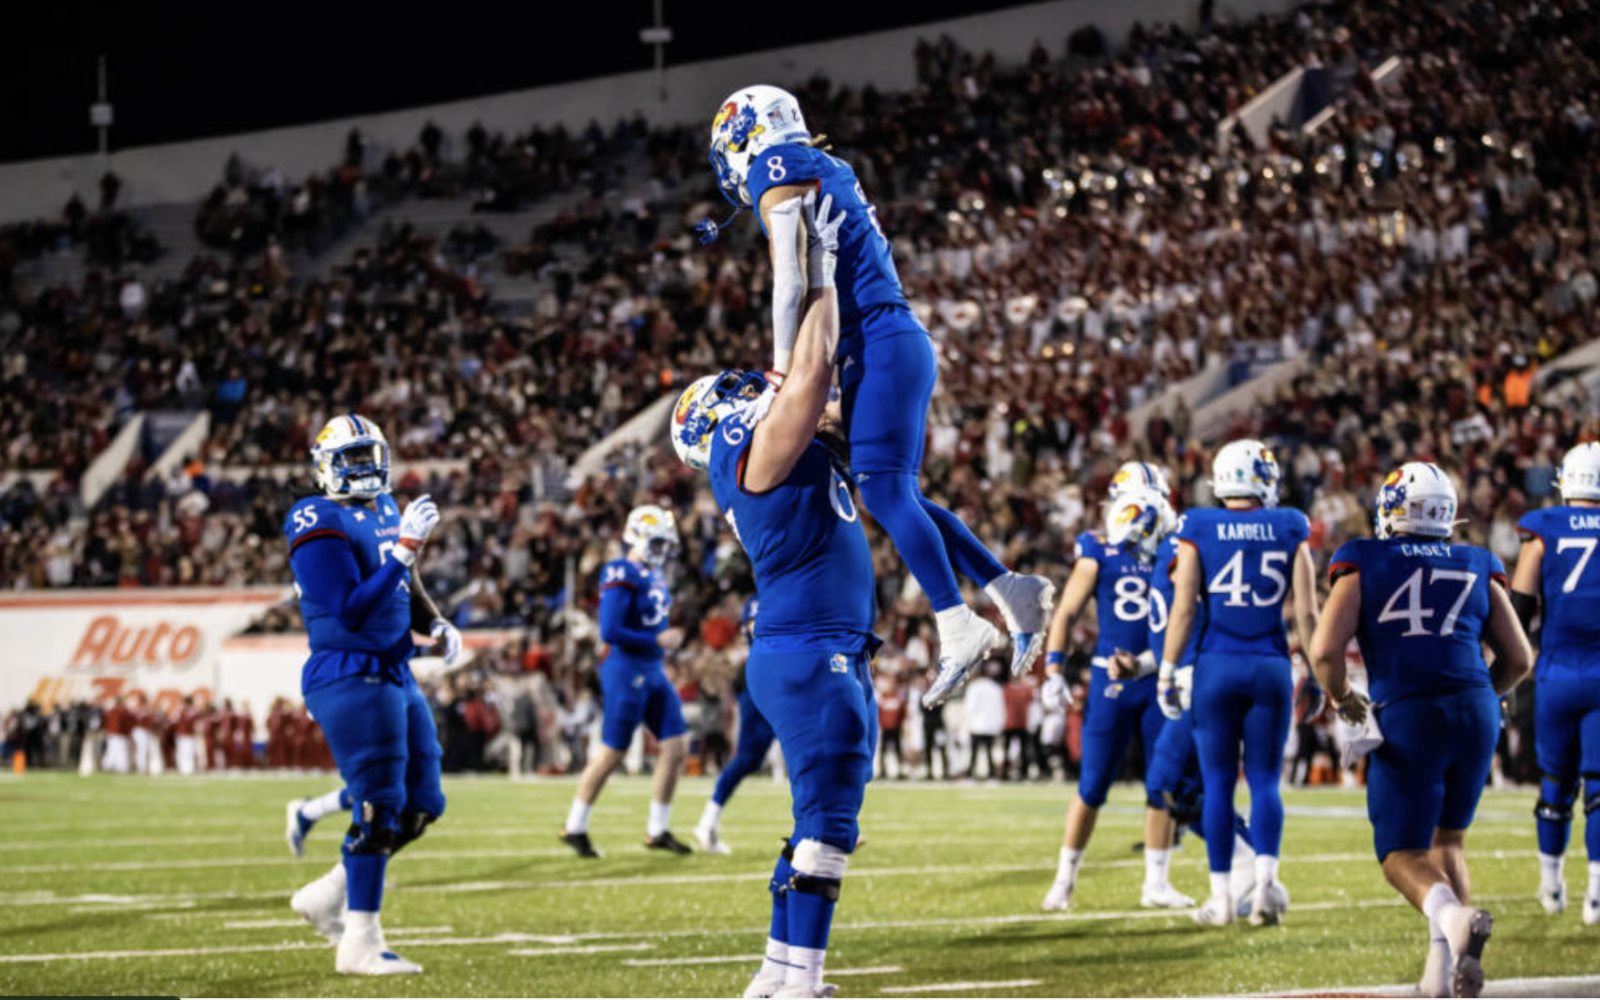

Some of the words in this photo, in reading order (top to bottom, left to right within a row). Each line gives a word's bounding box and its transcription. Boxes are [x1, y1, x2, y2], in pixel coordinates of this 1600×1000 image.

[767, 155, 786, 181] 8
[723, 415, 745, 446] 6
[293, 504, 318, 533] 55
[1427, 506, 1447, 520] 47
[1216, 522, 1277, 541] KARDELL
[1208, 550, 1288, 607] 45
[1556, 537, 1599, 594] 7
[1377, 567, 1477, 637] 47
[70, 615, 202, 664] Auto
